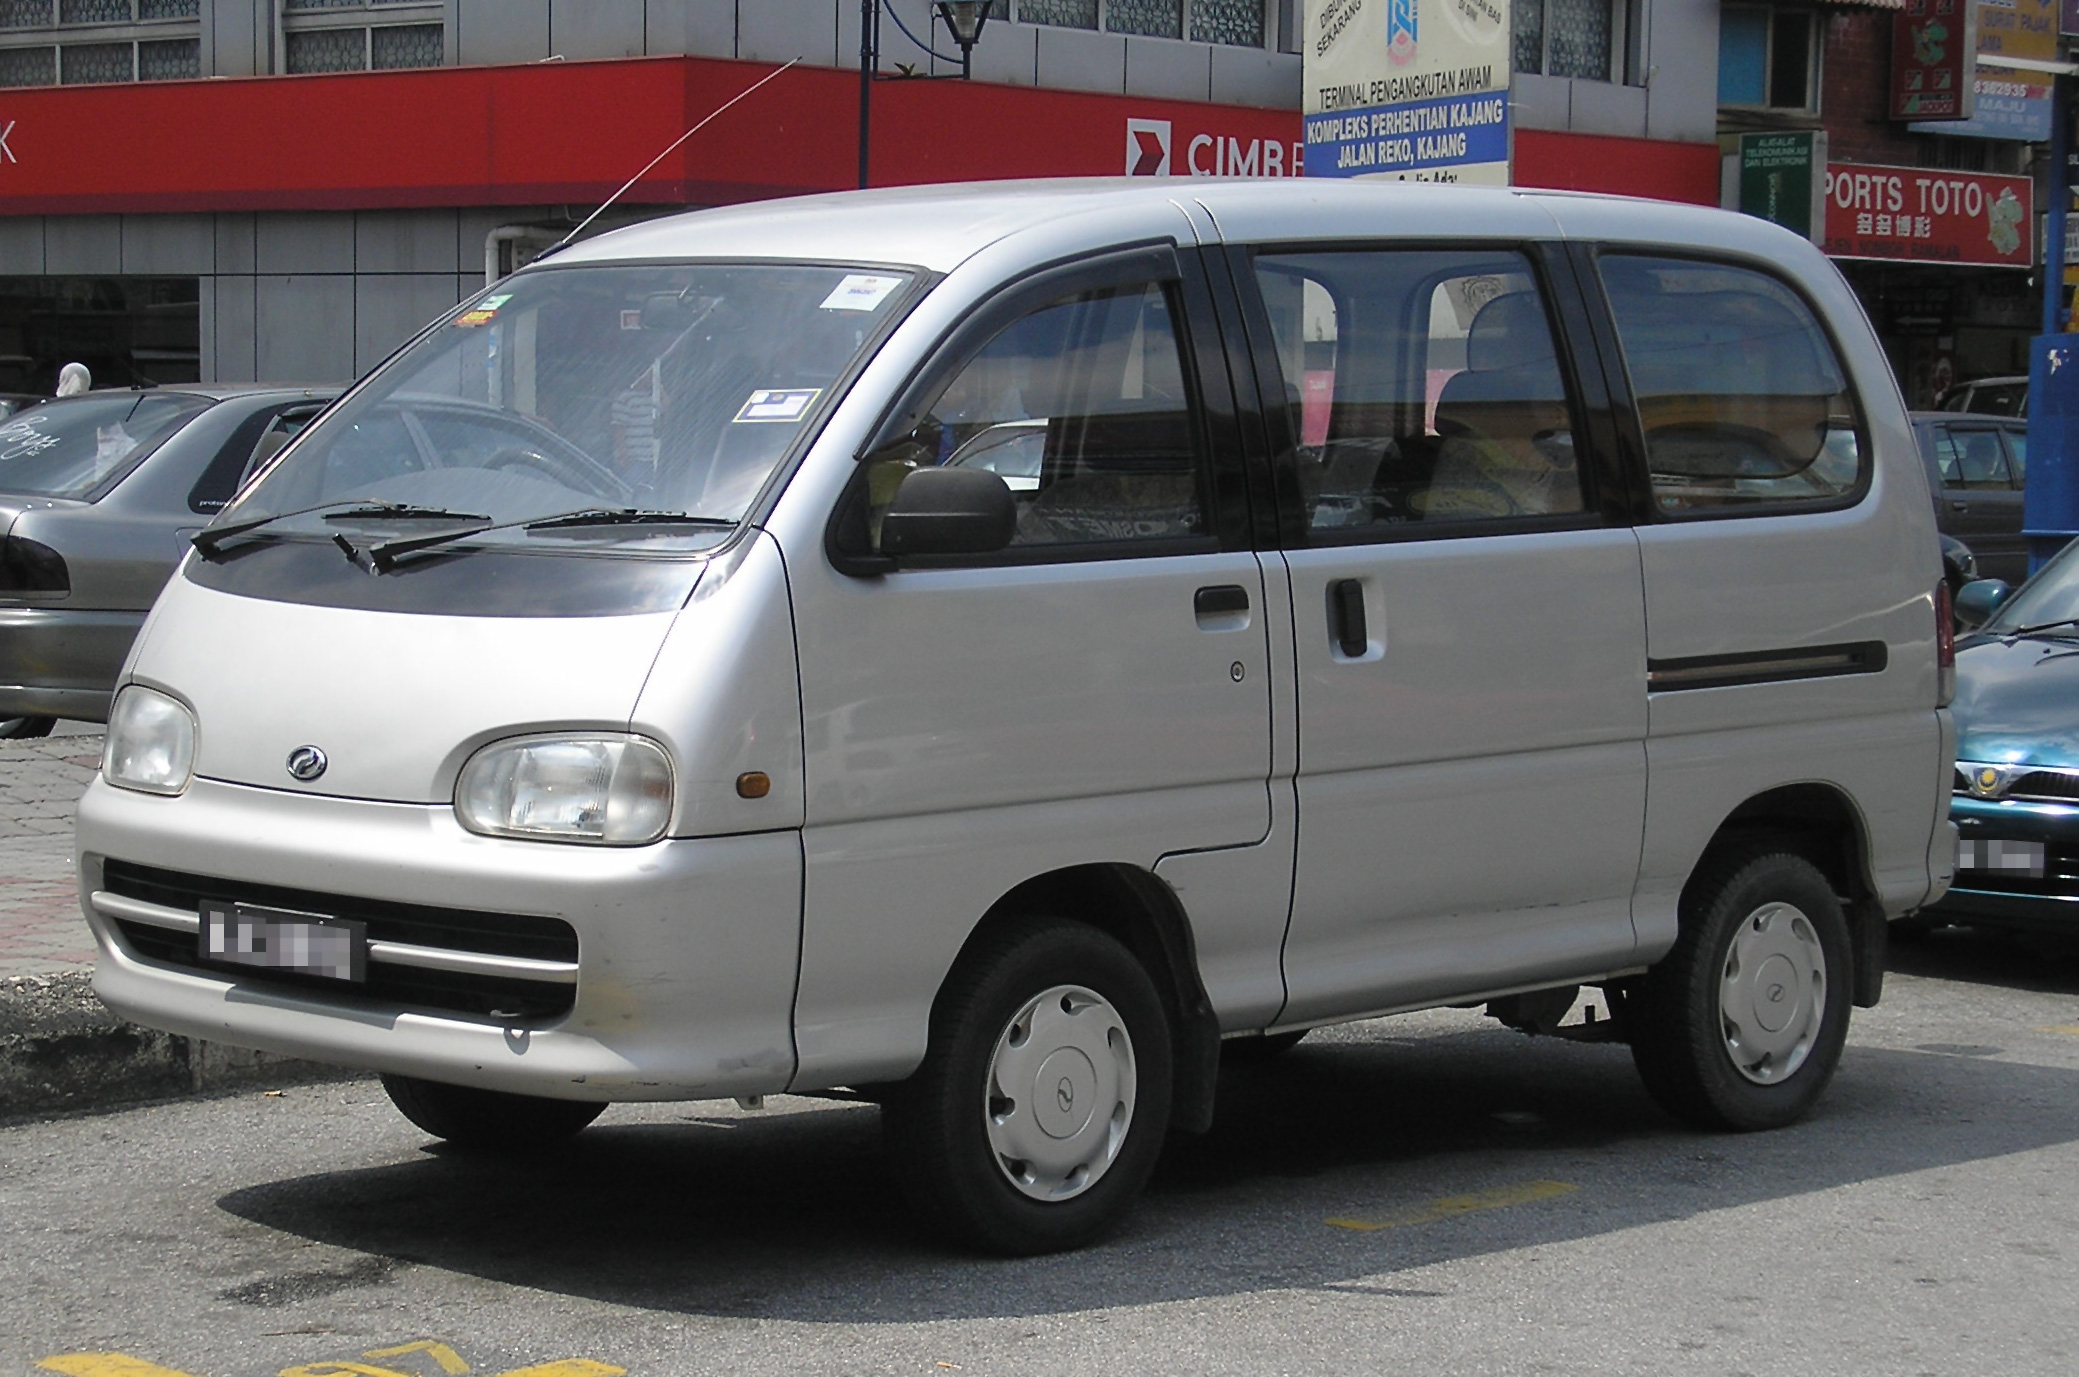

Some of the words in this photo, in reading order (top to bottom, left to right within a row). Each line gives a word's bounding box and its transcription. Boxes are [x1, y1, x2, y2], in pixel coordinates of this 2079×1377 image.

[1316, 0, 1362, 57] SEKARANG
[1319, 87, 1368, 109] TERMINAL
[1370, 72, 1456, 104] PENGANGKUTAN
[1458, 65, 1493, 89] AWAM
[1978, 98, 2027, 113] MAJU
[1307, 115, 1369, 144] KOMPLEKS
[1371, 106, 1448, 137] PERHENTIAN
[1450, 99, 1503, 127] KAJANG
[1188, 133, 1285, 177] CIMB
[1337, 143, 1375, 169] JALAN
[1378, 140, 1415, 167] REKO,
[1417, 133, 1466, 160] KAJANG
[1744, 158, 1761, 168] DAN
[1915, 178, 1983, 218] TOTO
